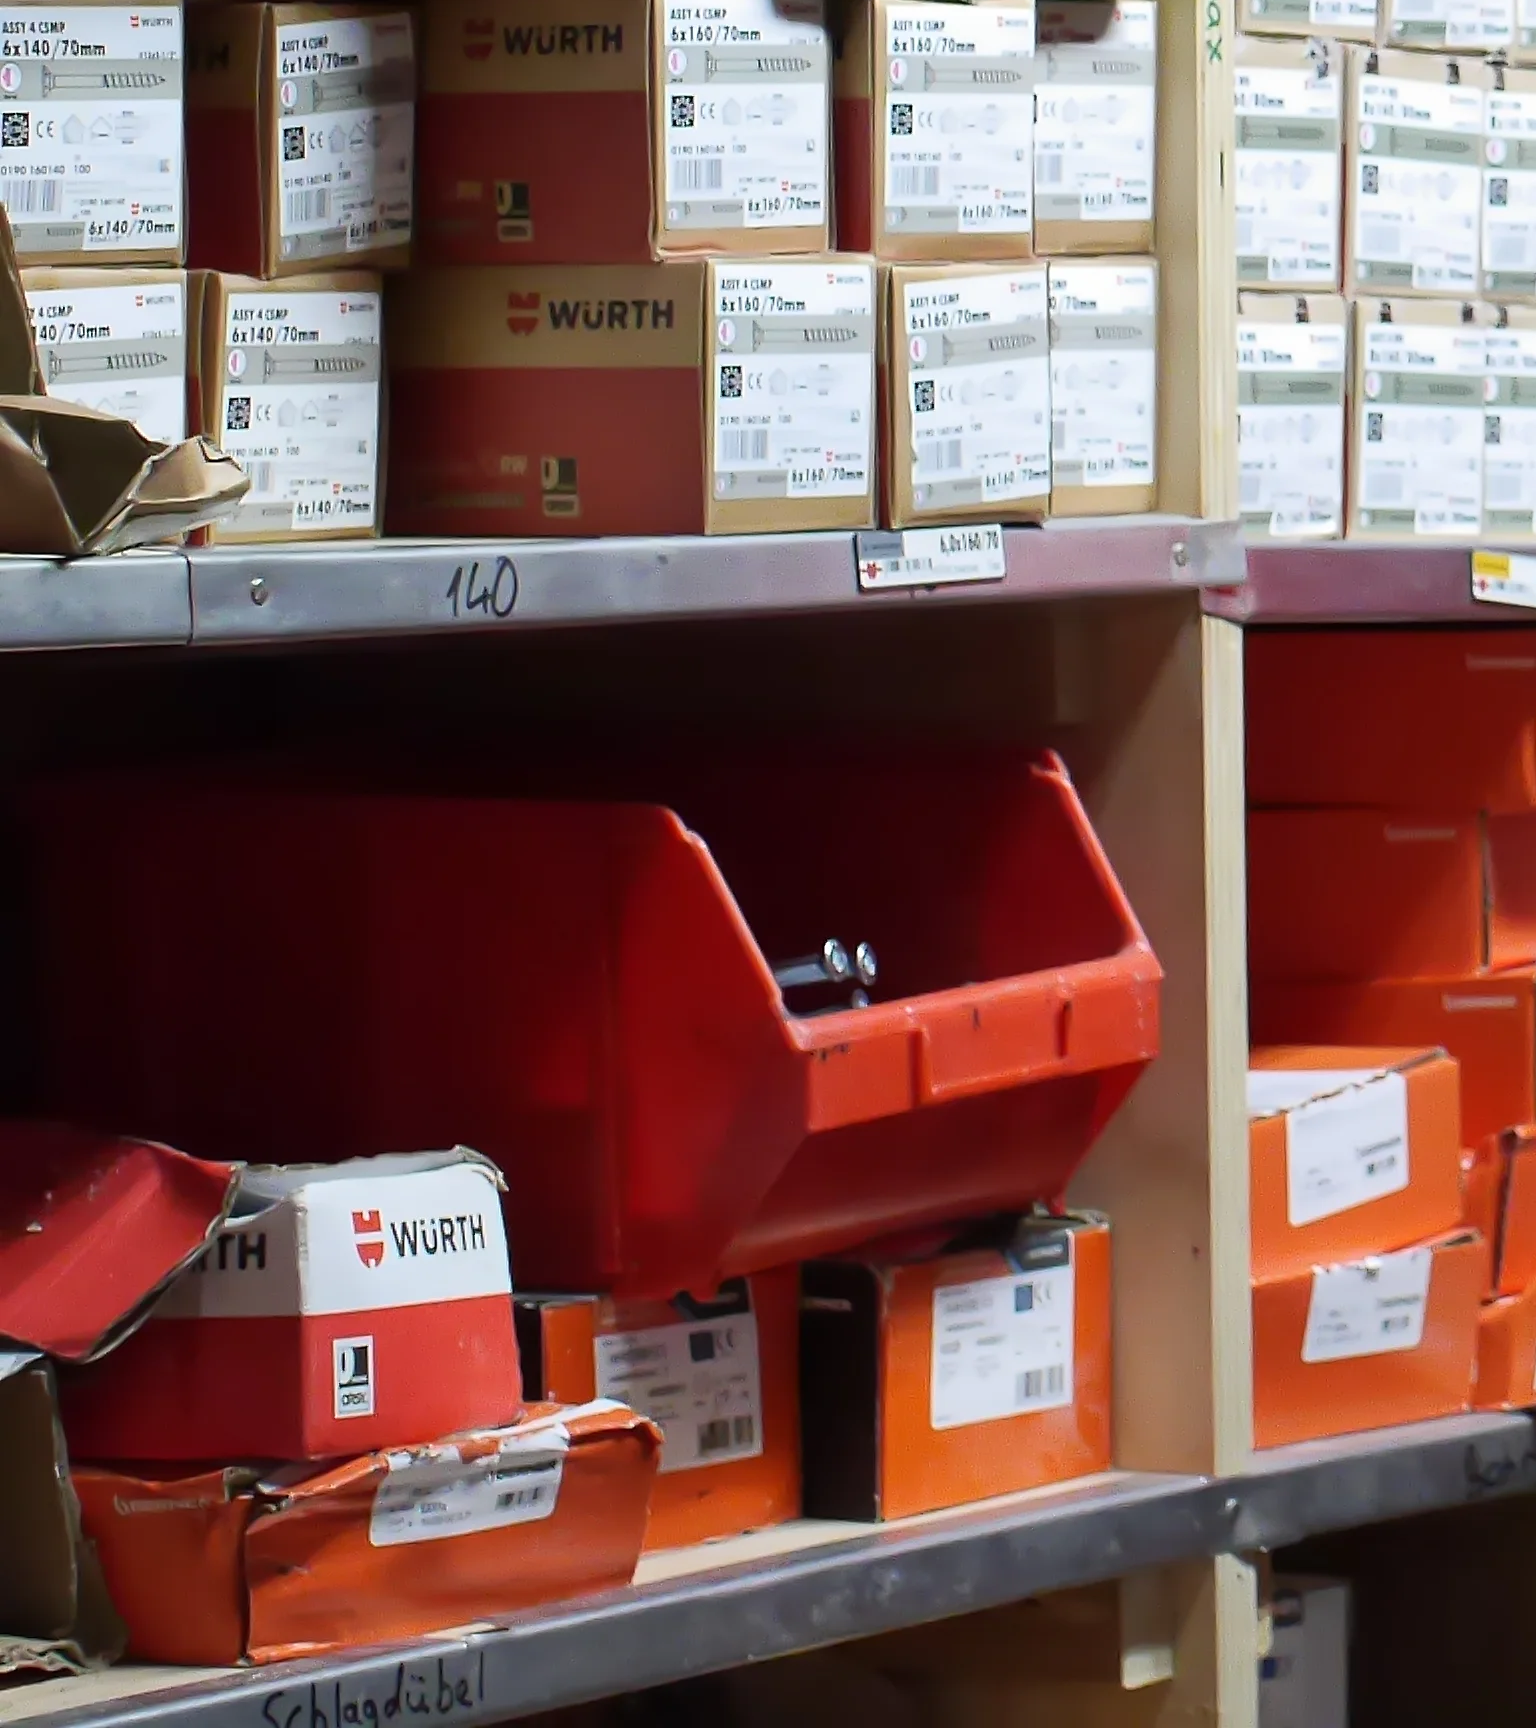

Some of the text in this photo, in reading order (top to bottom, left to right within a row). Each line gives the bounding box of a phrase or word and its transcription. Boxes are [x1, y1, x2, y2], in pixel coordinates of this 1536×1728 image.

[503, 22, 624, 56] WÜRTH
[671, 25, 761, 47] 6x160/70mm
[2, 39, 106, 62] 6x140/70mm
[88, 219, 175, 238] 6x140/70mm
[548, 299, 674, 331] WÜRTH
[721, 296, 806, 316] 6x160/70mm
[232, 326, 320, 345] 6x140/70mm
[447, 555, 519, 618] 140
[390, 1213, 486, 1258] WÜRTH
[262, 1651, 484, 1728] Schlagdübel
